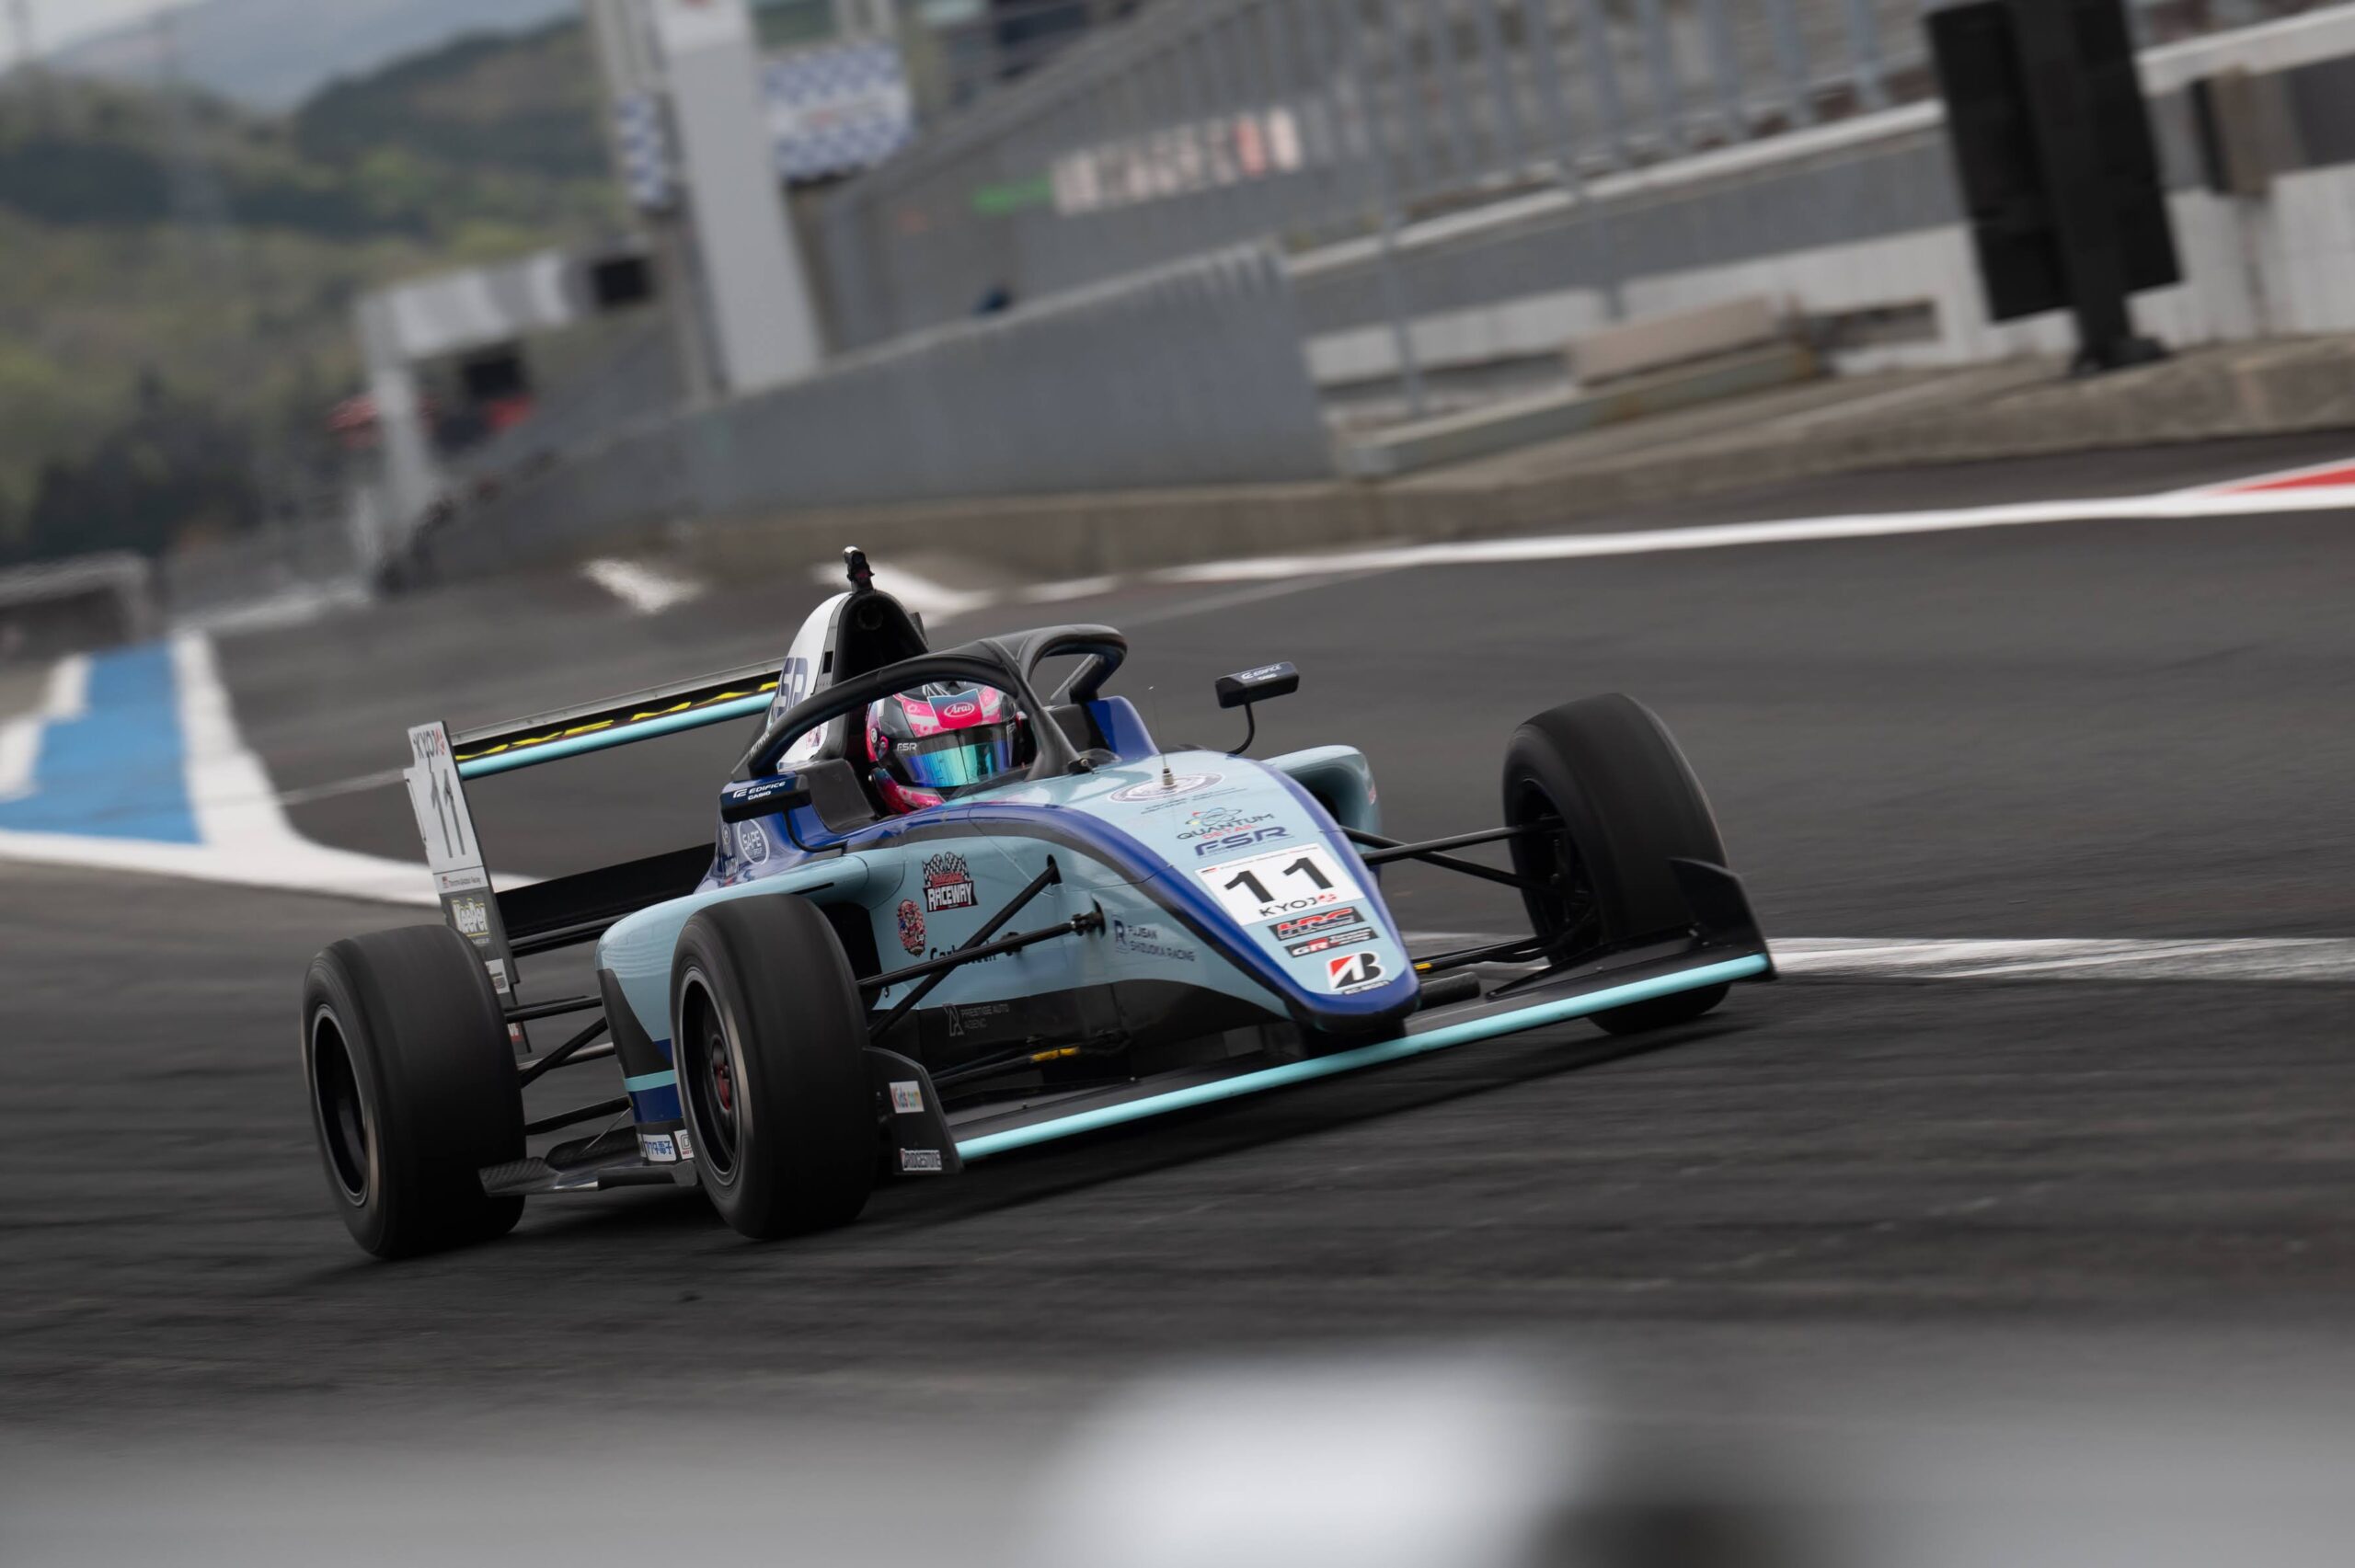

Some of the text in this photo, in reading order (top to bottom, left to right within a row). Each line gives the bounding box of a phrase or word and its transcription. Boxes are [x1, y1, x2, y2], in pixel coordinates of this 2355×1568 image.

[949, 704, 971, 715] Arai
[897, 742, 918, 751] FSR
[748, 790, 771, 800] CASIO
[749, 782, 786, 795] EDIFICE
[1177, 813, 1275, 840] QUANTUM
[1194, 826, 1291, 856] FSR
[1223, 857, 1334, 903] 11
[927, 882, 972, 911] RACEWAY
[1277, 908, 1355, 938] HRC
